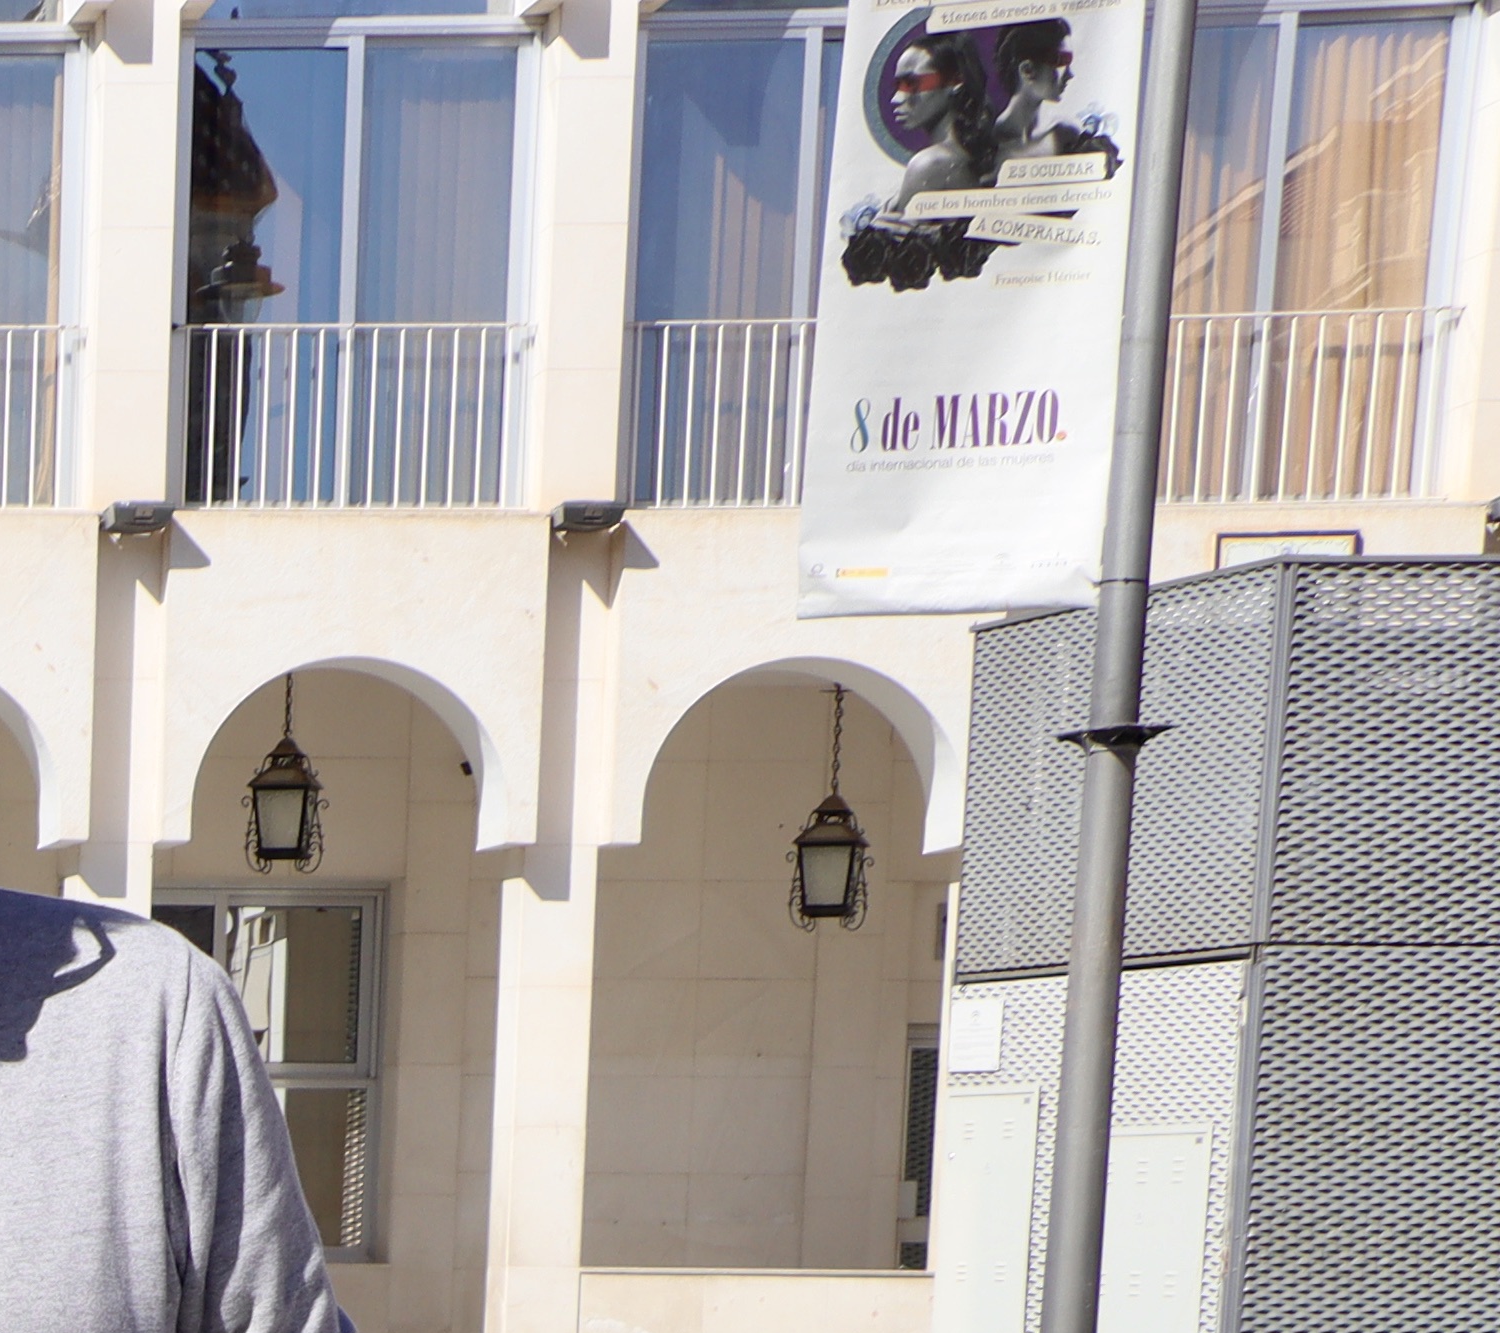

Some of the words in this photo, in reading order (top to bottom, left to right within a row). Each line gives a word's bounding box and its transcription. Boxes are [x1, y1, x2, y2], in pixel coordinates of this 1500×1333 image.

[941, 12, 988, 24] tienen
[991, 5, 1046, 19] derecho
[1008, 164, 1027, 179] ES
[1029, 161, 1095, 178] OCULTAR
[915, 200, 939, 215] que
[942, 197, 960, 209] los
[963, 193, 1018, 209] hombres
[1021, 192, 1058, 205] tienen
[1061, 187, 1112, 202] derecho
[975, 218, 986, 232] A
[990, 219, 1102, 246] COMPRARLAS.
[850, 397, 871, 454] 8
[881, 396, 920, 451] de
[870, 456, 953, 473] internacional
[956, 455, 975, 469] de
[978, 454, 997, 467] las
